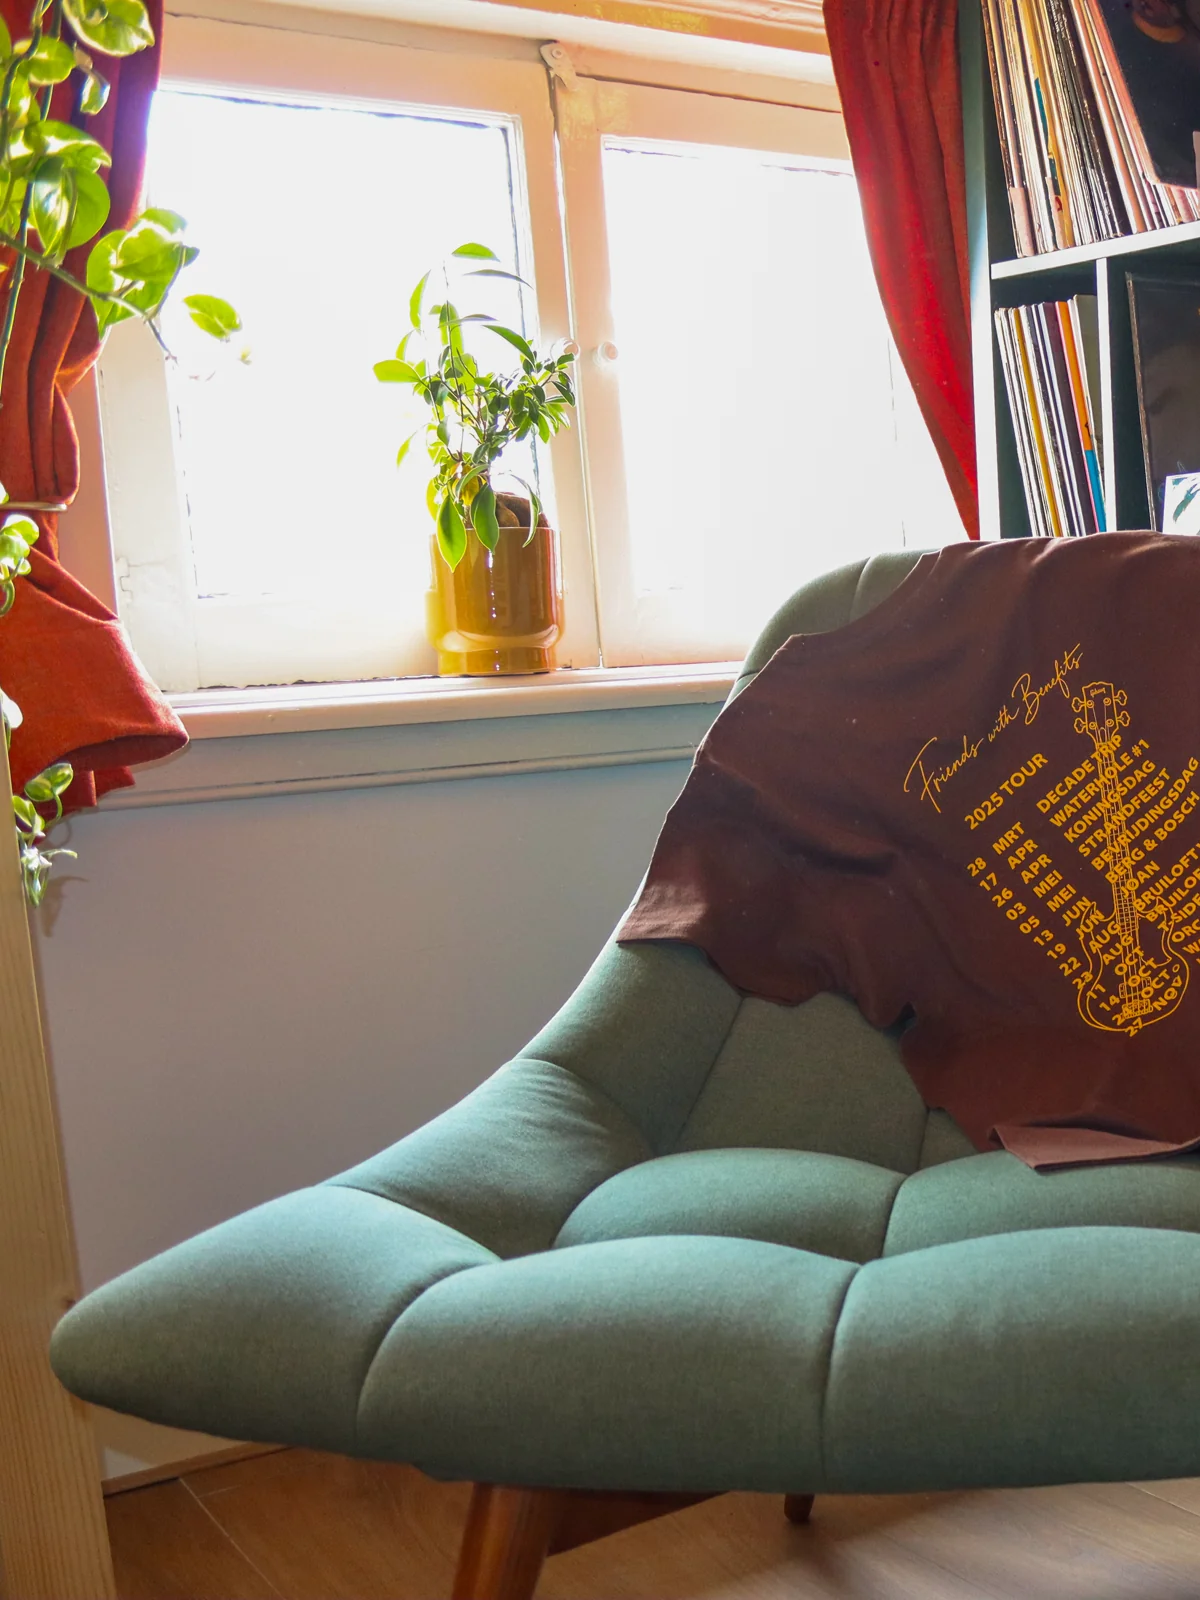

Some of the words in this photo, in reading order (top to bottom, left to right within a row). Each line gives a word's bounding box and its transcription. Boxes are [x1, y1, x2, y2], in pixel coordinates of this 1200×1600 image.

[903, 735, 984, 813] Friends
[988, 705, 1019, 742] with
[1011, 643, 1083, 725] Benefits
[964, 791, 1004, 830] 2025
[999, 752, 1049, 796] TOUR
[967, 857, 987, 877] 28
[992, 821, 1025, 855] MRT
[1036, 759, 1095, 814] DECADE
[1090, 734, 1122, 764] TRIP
[979, 872, 998, 891] 17
[1007, 839, 1039, 870] APR
[1049, 752, 1134, 828] WATERHOLE
[1131, 738, 1150, 758] #1
[992, 887, 1013, 908] 26
[1021, 853, 1053, 885] APR
[1063, 759, 1156, 843] KONINGSDAG
[1006, 902, 1027, 921] 03
[1032, 869, 1063, 899] MEI
[1078, 767, 1171, 857] STRANDFEEST
[1019, 915, 1040, 934] 05
[1046, 883, 1077, 913] MEI
[1090, 756, 1200, 871] BEVRIJDINGSDAG
[1033, 929, 1054, 946] 13
[1062, 896, 1092, 927] JUN
[1104, 847, 1146, 884] BERG
[1143, 839, 1158, 851] &
[1153, 790, 1200, 841] BOSCH
[1047, 943, 1067, 960] 19
[1075, 909, 1105, 941] JUN
[1119, 860, 1160, 898] JOAN
[1059, 956, 1082, 976] 22
[1088, 920, 1122, 954] AUG
[1133, 847, 1198, 911] BRUILOFT
[1072, 971, 1093, 990] 23
[1102, 934, 1134, 966] AUG
[1086, 983, 1106, 1000] 11
[1114, 945, 1145, 976] OCT
[1099, 995, 1120, 1012] 14
[1127, 957, 1158, 988] OCT
[1125, 1016, 1144, 1038] 27
[1152, 975, 1183, 1011] NOV
[1140, 968, 1171, 999] OCT
